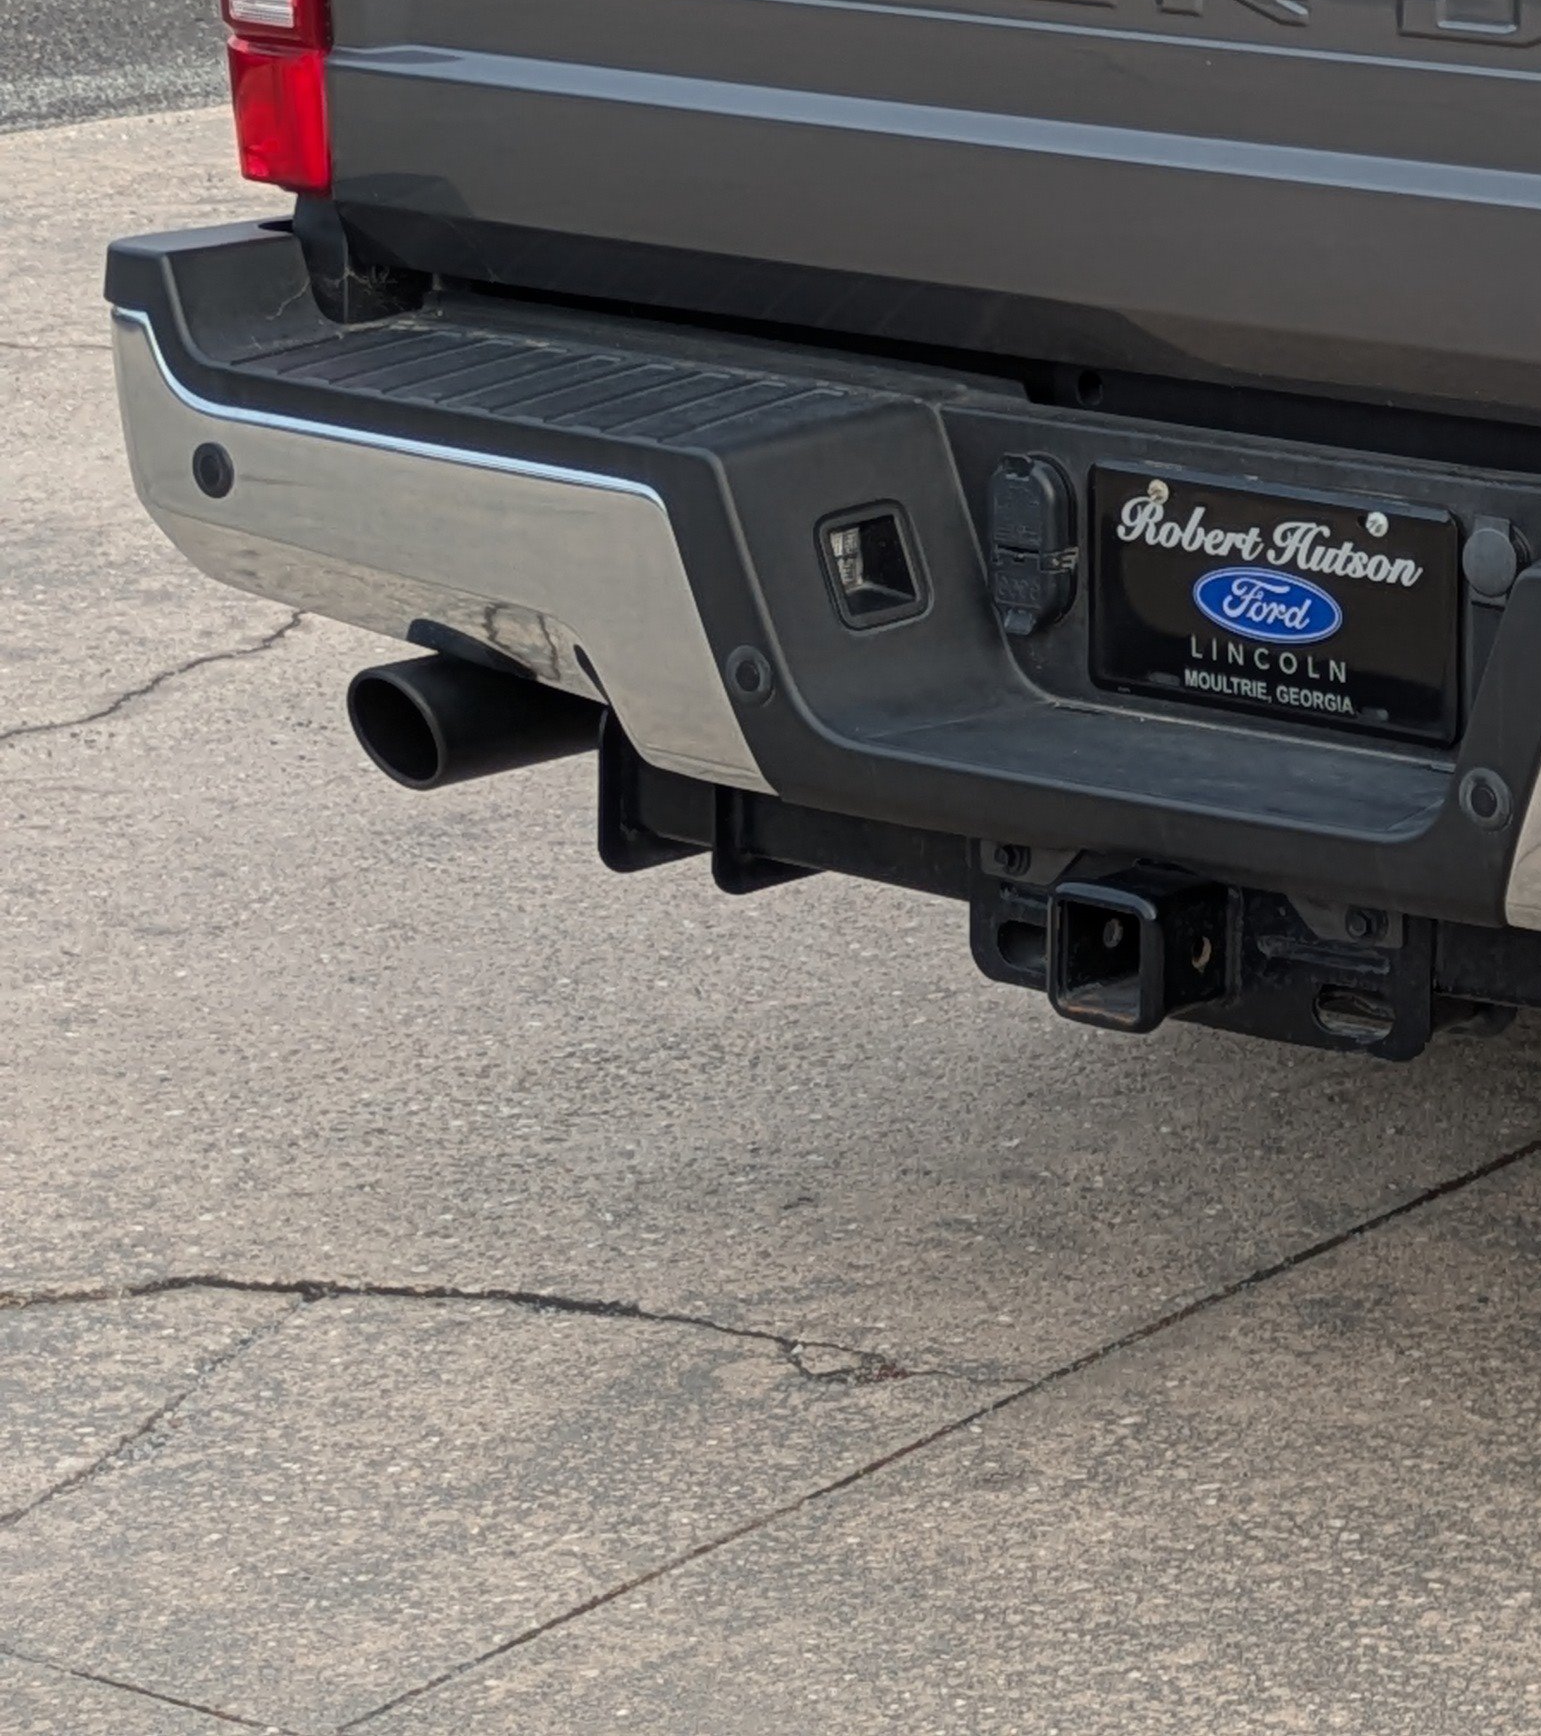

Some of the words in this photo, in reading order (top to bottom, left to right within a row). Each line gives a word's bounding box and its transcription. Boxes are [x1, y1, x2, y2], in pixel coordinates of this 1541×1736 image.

[1116, 496, 1264, 562] Robert
[1266, 521, 1423, 587] Hutson
[1222, 577, 1313, 631] Ford
[1190, 634, 1348, 683] LINCOLN
[1184, 668, 1272, 704] MOULTRIE,
[1276, 685, 1354, 715] GEORGIA
